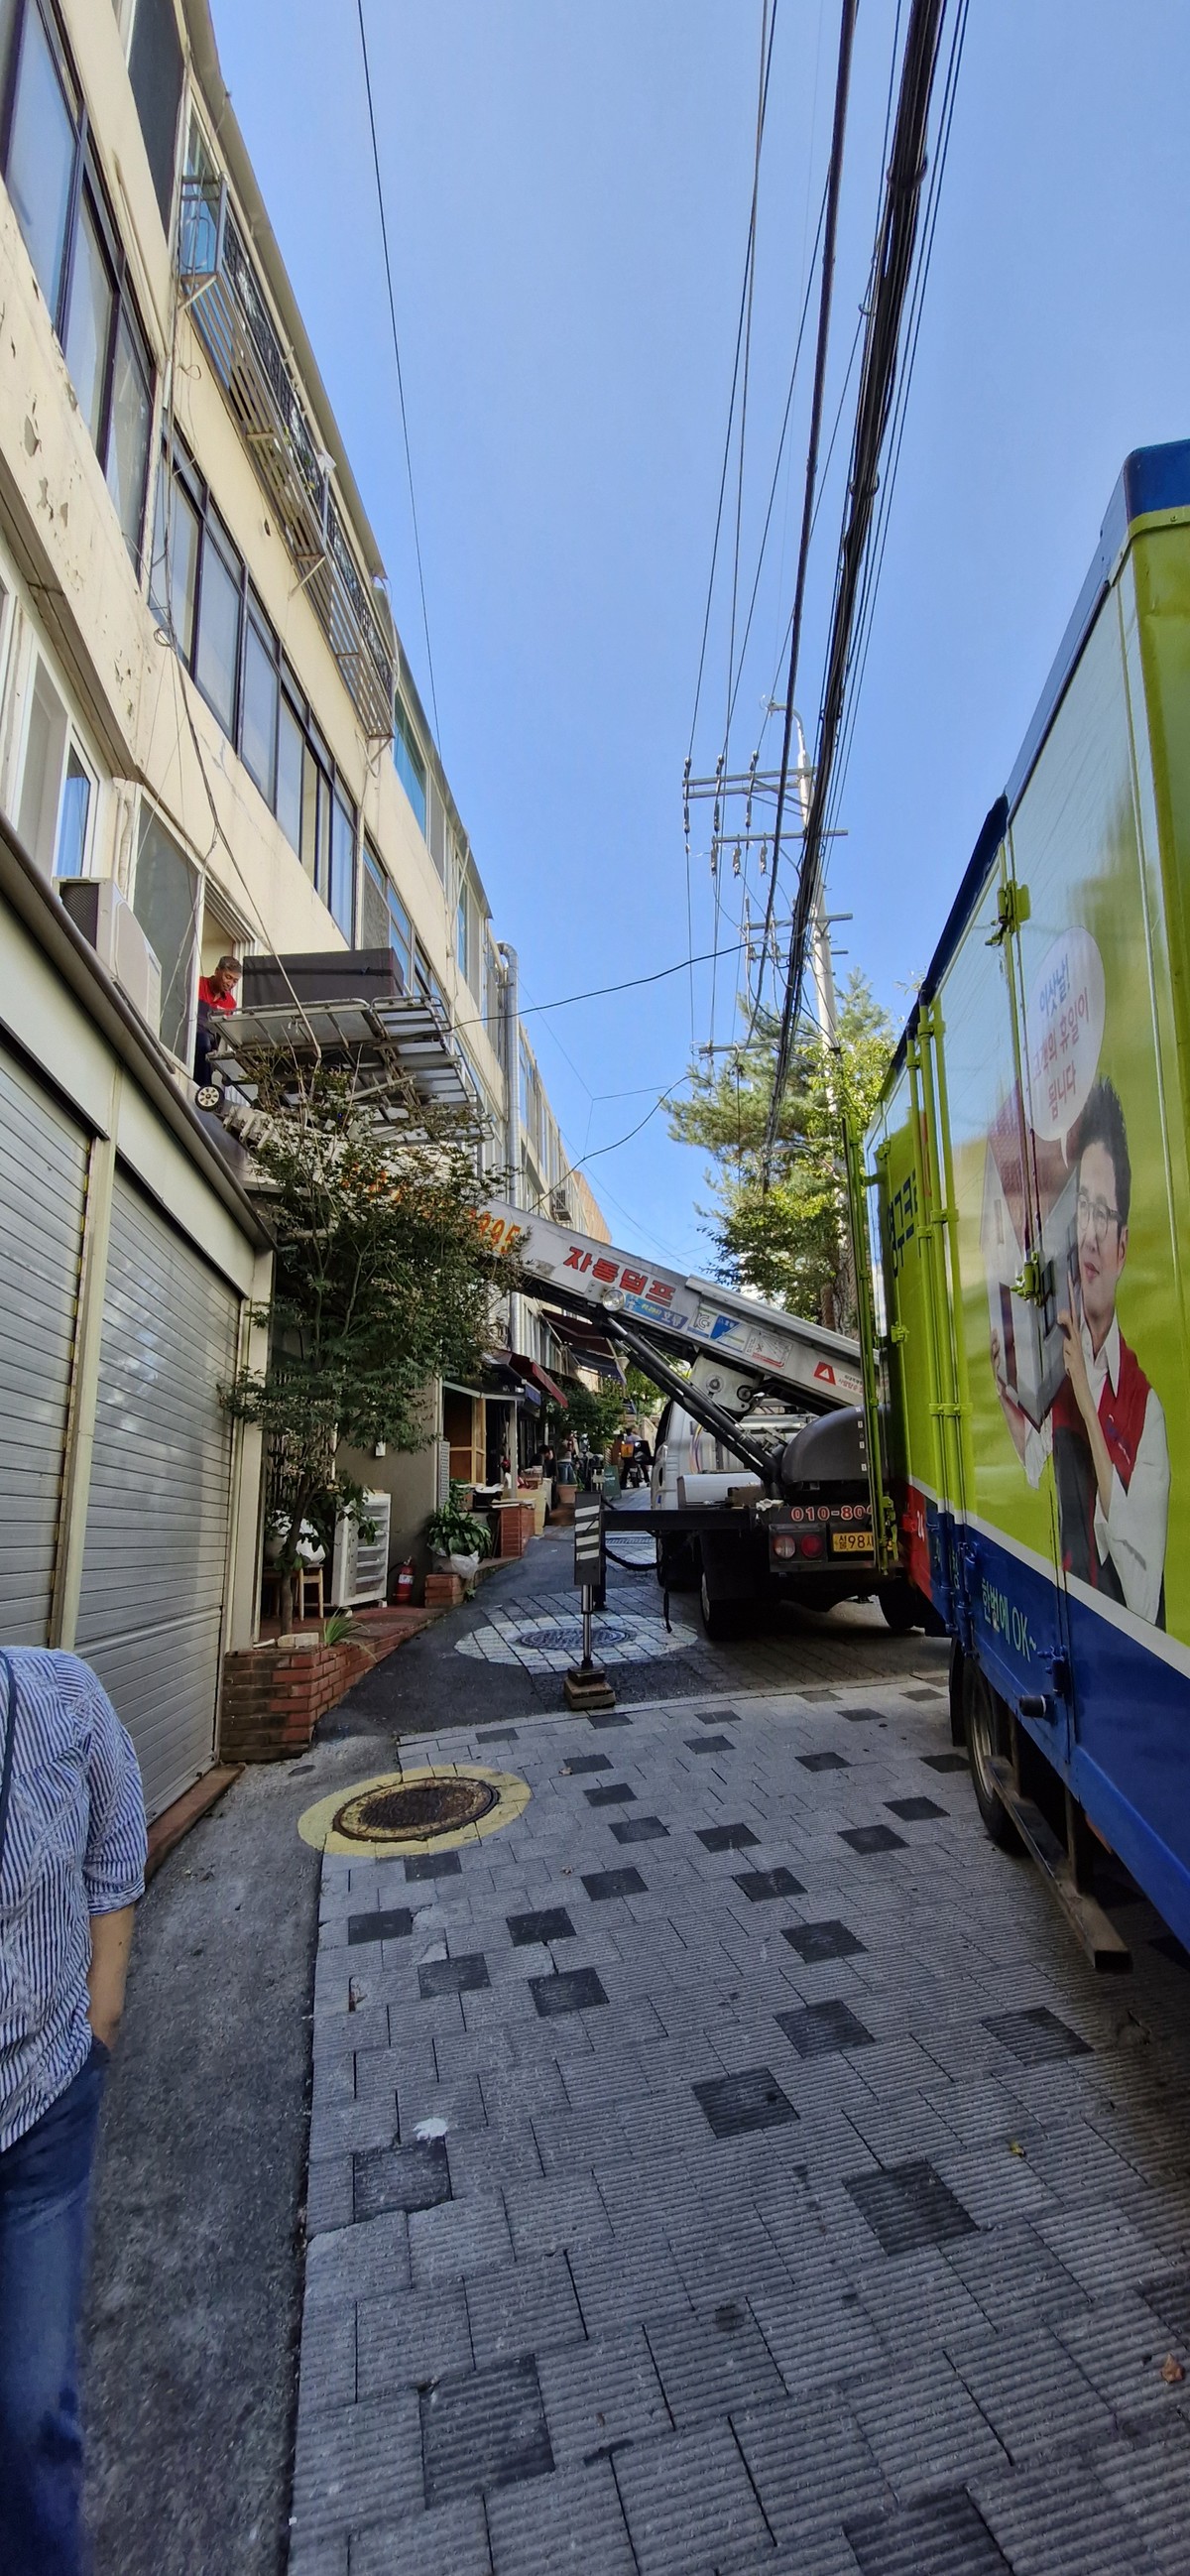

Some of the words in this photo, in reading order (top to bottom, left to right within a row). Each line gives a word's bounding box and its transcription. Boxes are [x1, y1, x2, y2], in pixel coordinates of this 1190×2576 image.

[1059, 987, 1089, 1052] 휴일이
[1048, 1060, 1076, 1121] 됩니다
[562, 1246, 676, 1308] 자동덤프
[982, 1577, 1011, 1646] 한번에
